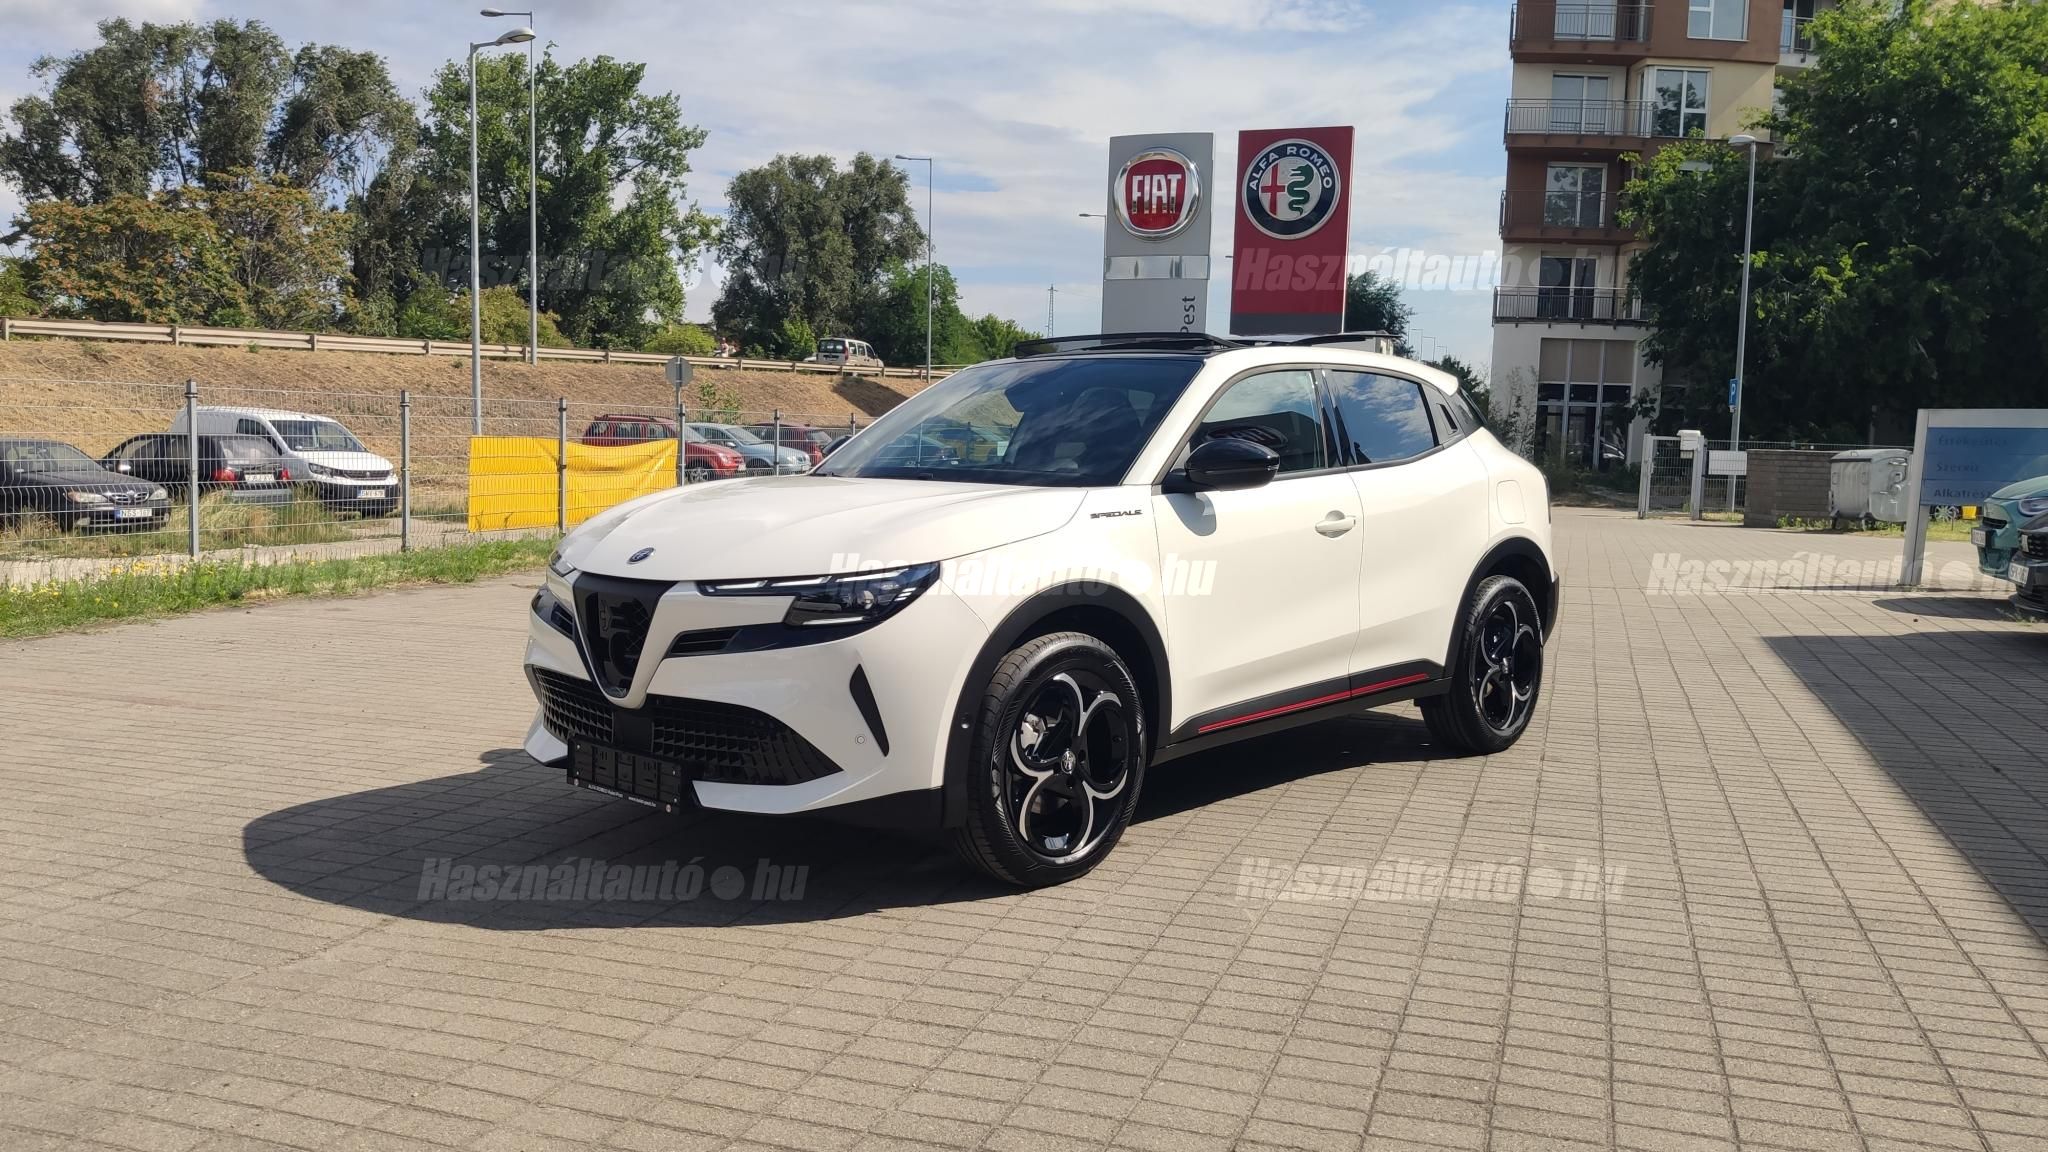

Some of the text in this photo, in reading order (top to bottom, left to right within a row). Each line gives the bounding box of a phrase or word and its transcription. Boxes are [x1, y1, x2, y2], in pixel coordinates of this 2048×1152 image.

[1249, 146, 1332, 190] ALFA ROMEO
[1131, 174, 1182, 214] FIAT
[1731, 383, 1736, 404] P
